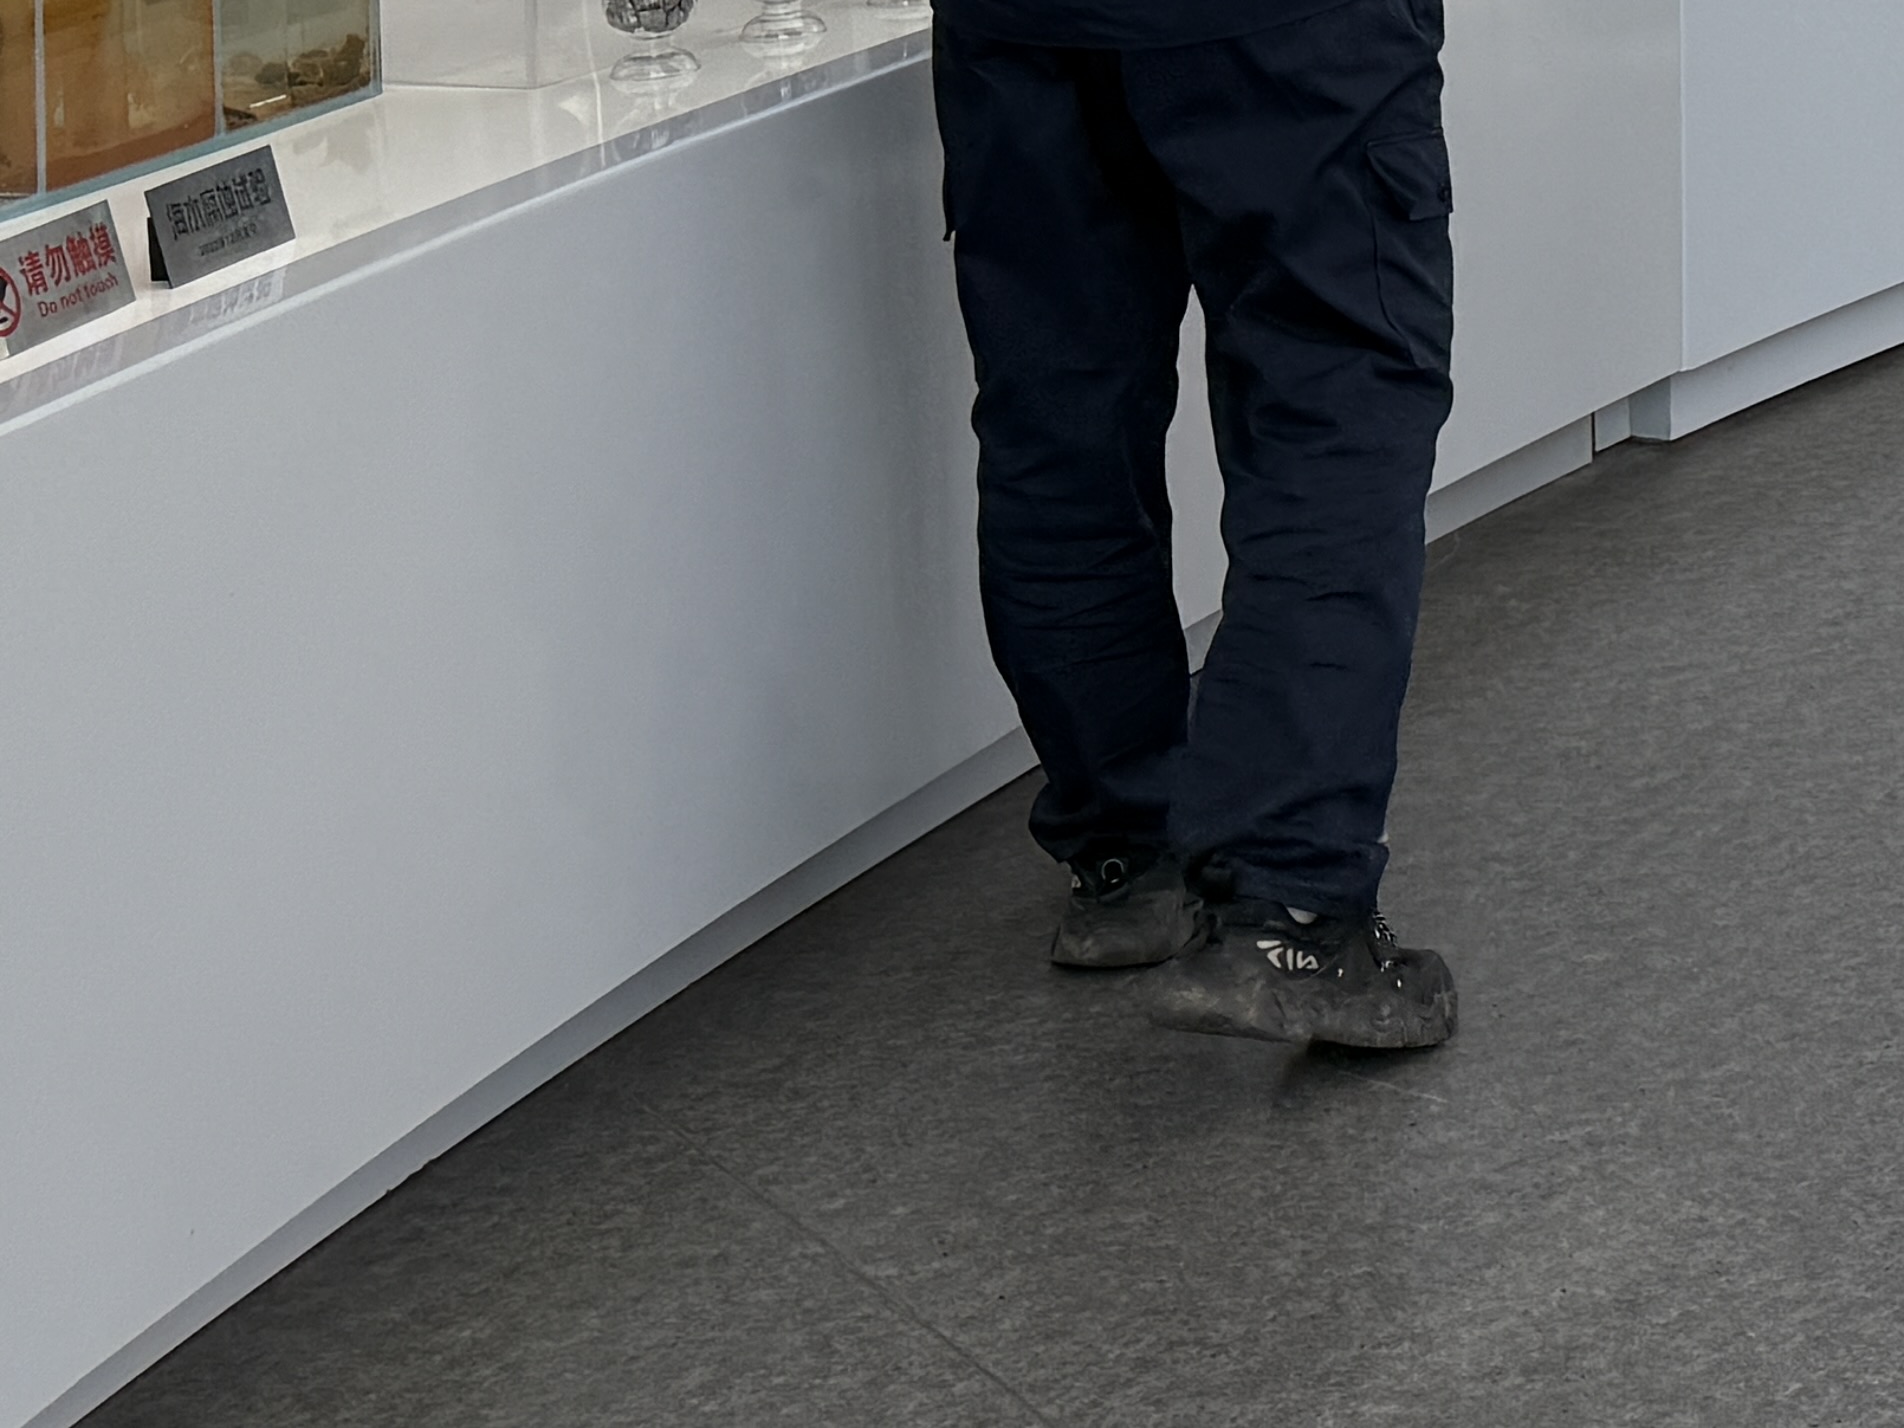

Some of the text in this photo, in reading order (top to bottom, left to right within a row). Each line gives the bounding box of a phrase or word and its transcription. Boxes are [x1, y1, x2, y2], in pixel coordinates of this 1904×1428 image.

[18, 222, 117, 296] 请勿触摸
[37, 271, 119, 317] Do not touch
